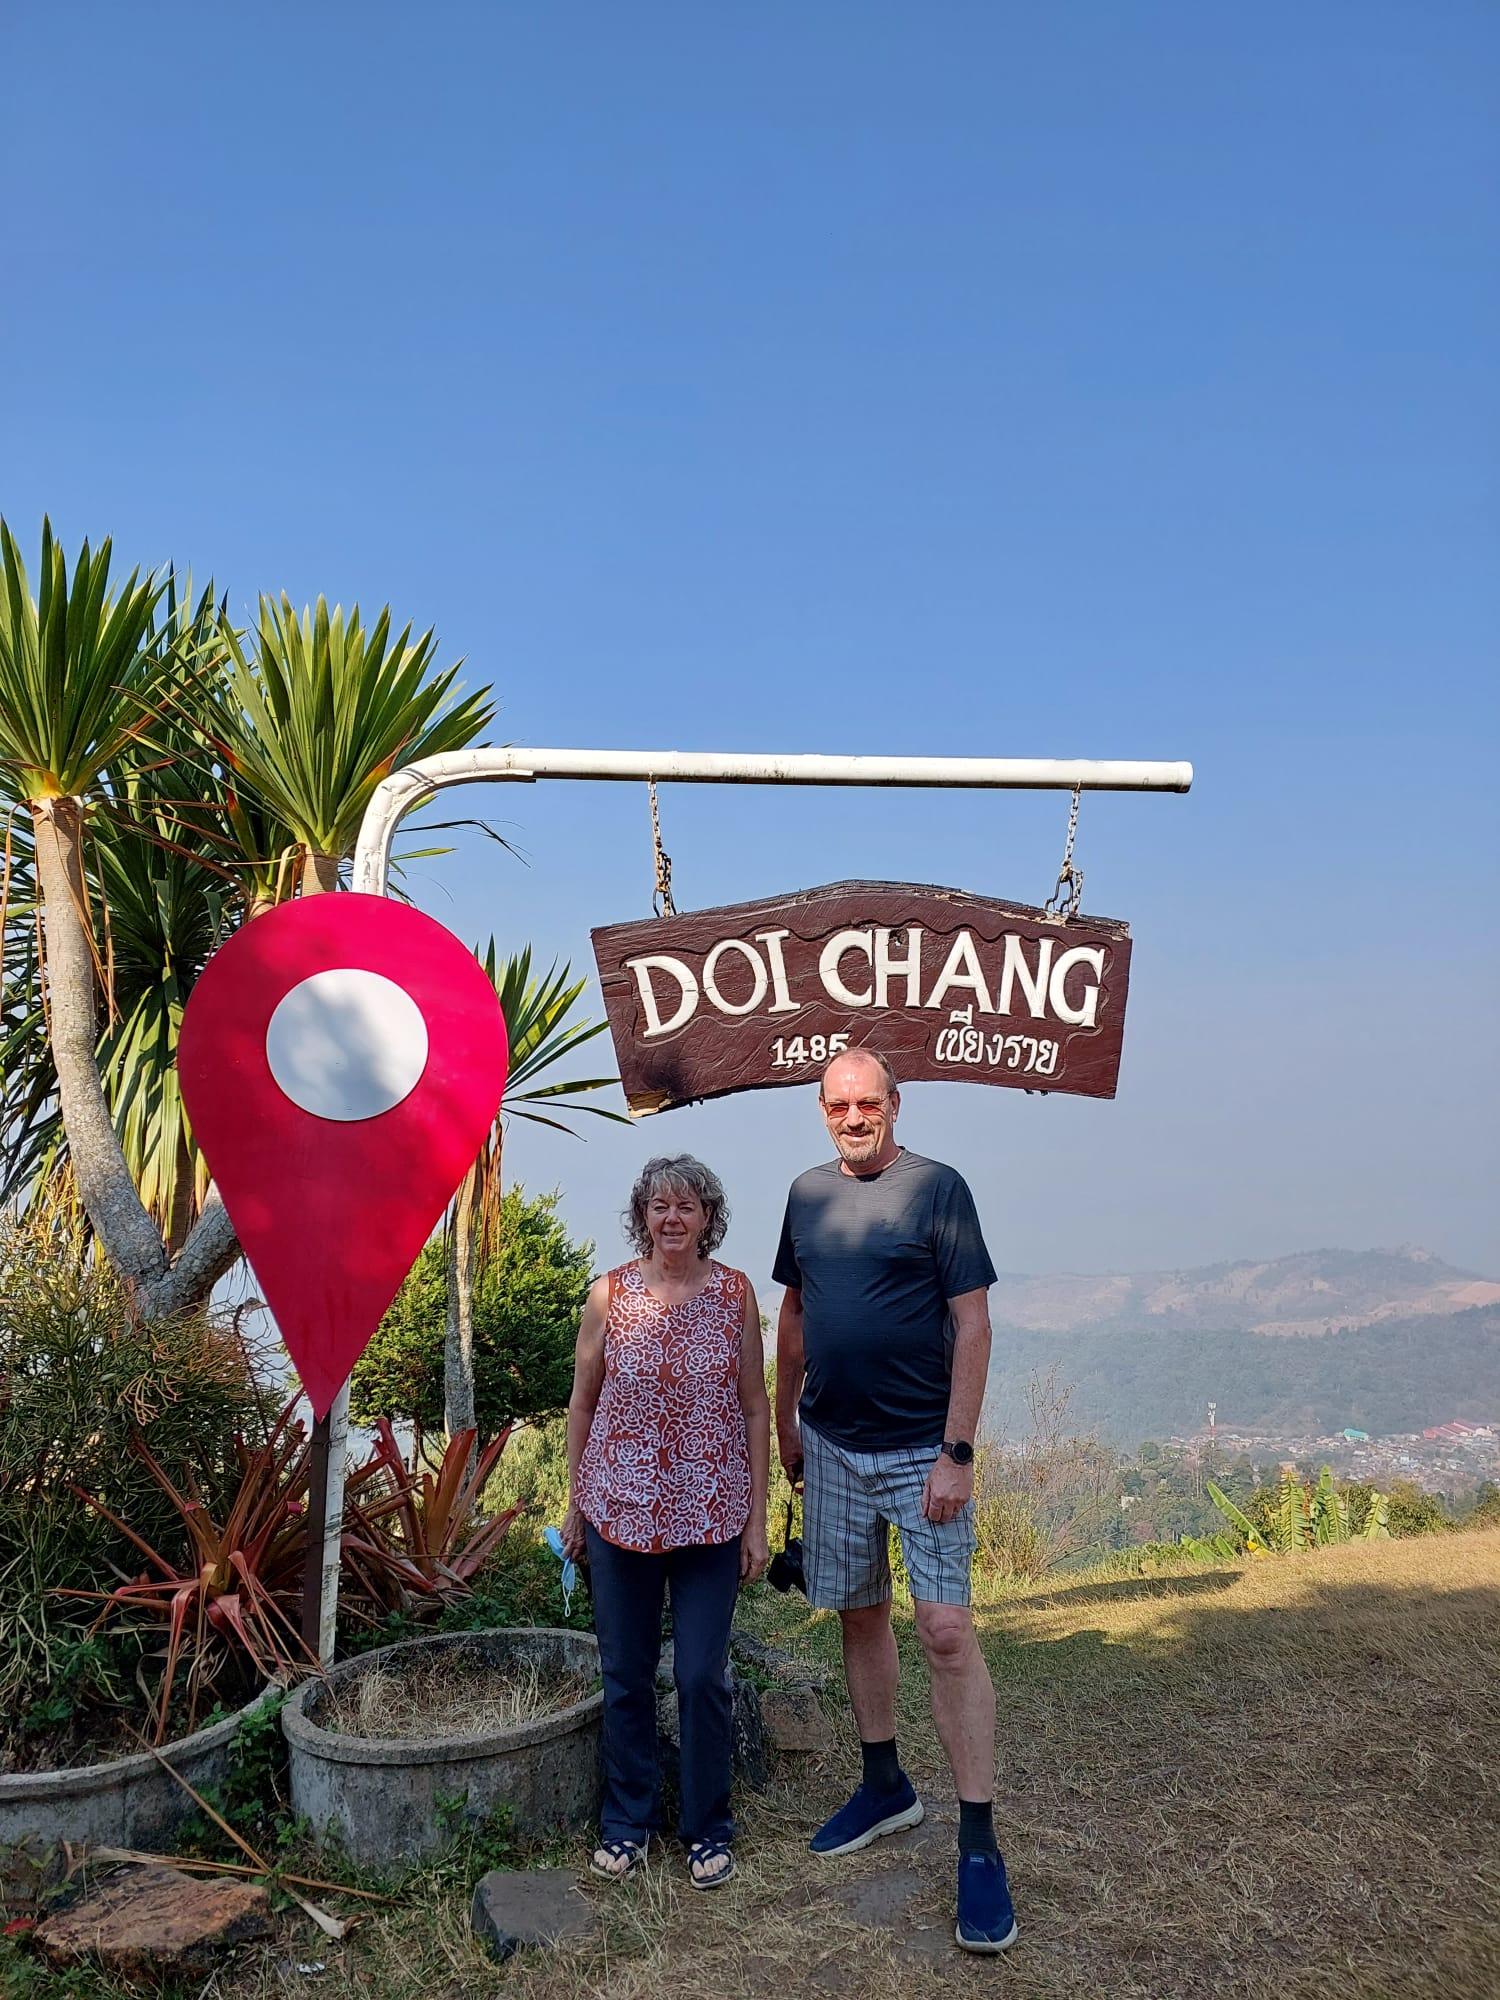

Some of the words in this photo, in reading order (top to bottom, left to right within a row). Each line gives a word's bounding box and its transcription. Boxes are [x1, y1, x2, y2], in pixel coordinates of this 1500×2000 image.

[626, 930, 801, 1037] DOI
[819, 928, 1105, 1027] CHANG
[935, 1003, 1059, 1075] เชียงราย
